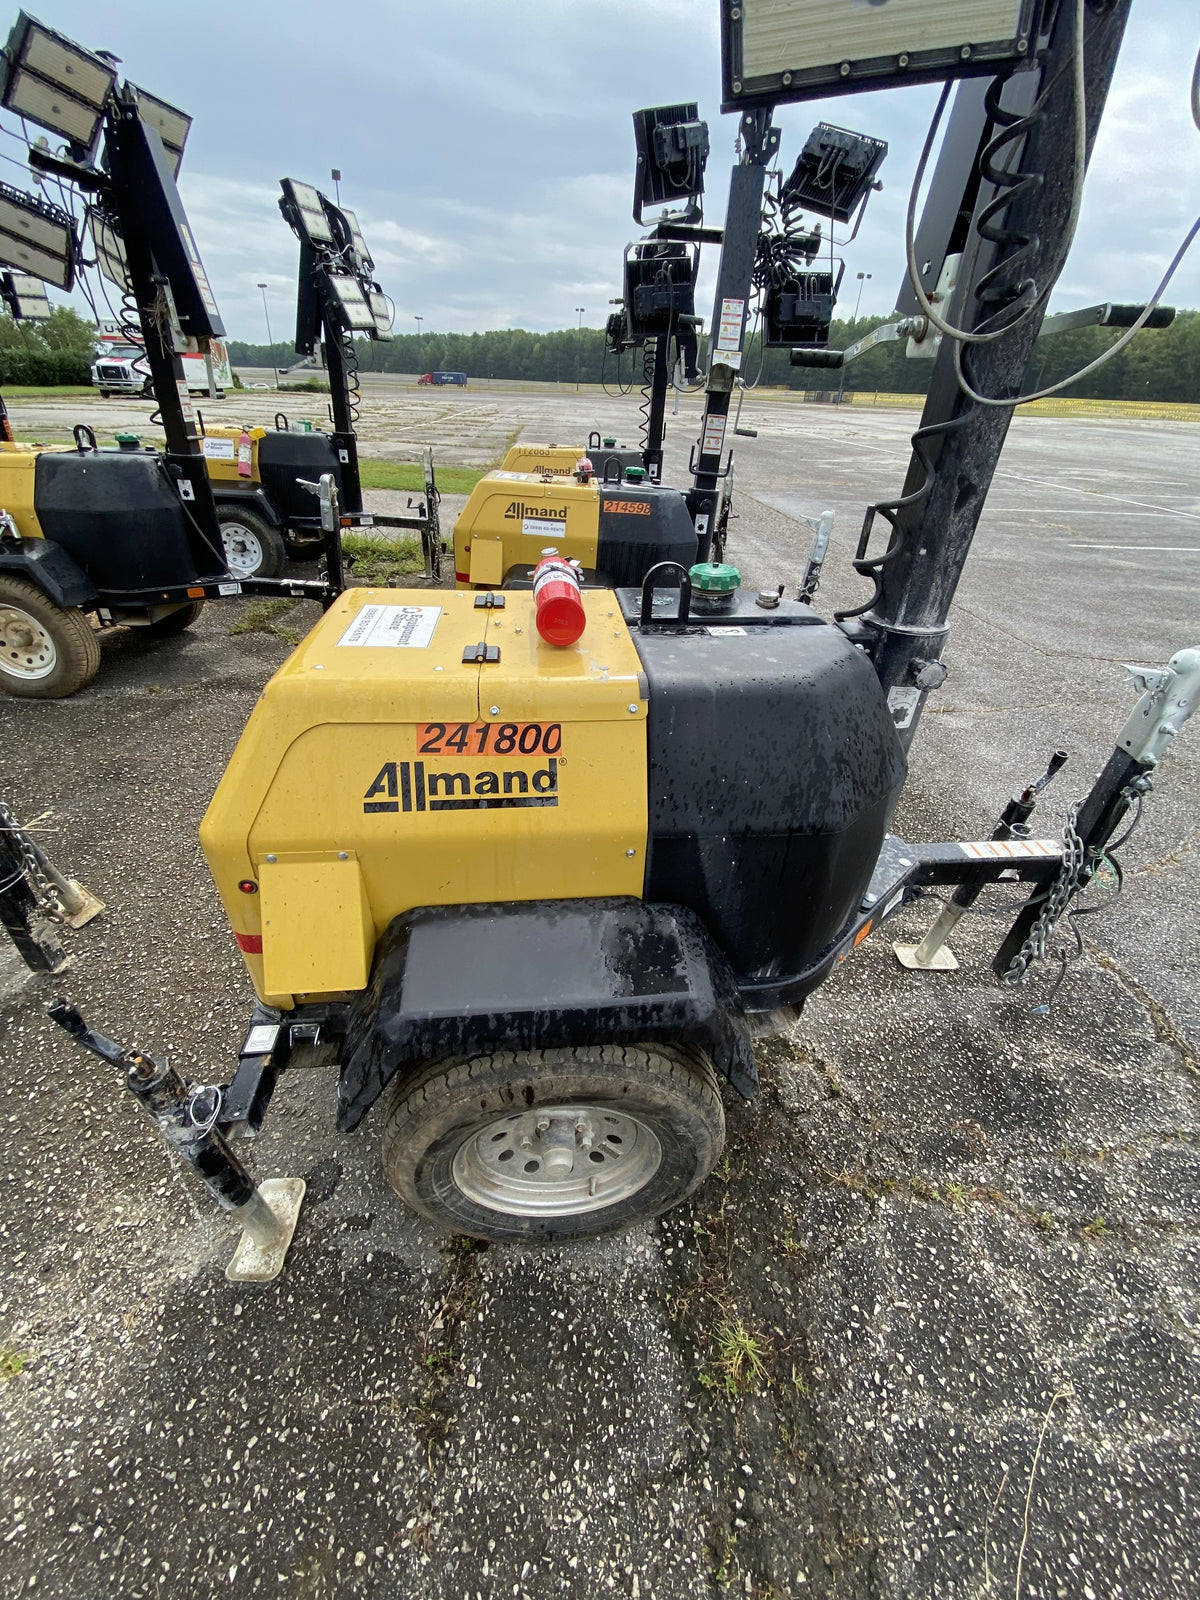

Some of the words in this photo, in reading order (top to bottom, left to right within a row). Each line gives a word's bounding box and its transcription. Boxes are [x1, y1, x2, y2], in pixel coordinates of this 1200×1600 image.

[532, 465, 571, 476] Allmand
[504, 502, 567, 521] Allmand
[604, 501, 651, 514] 214598
[389, 613, 407, 630] Share
[397, 614, 423, 645] Equipment
[419, 723, 562, 753] 241800
[364, 758, 558, 812] Allmand
